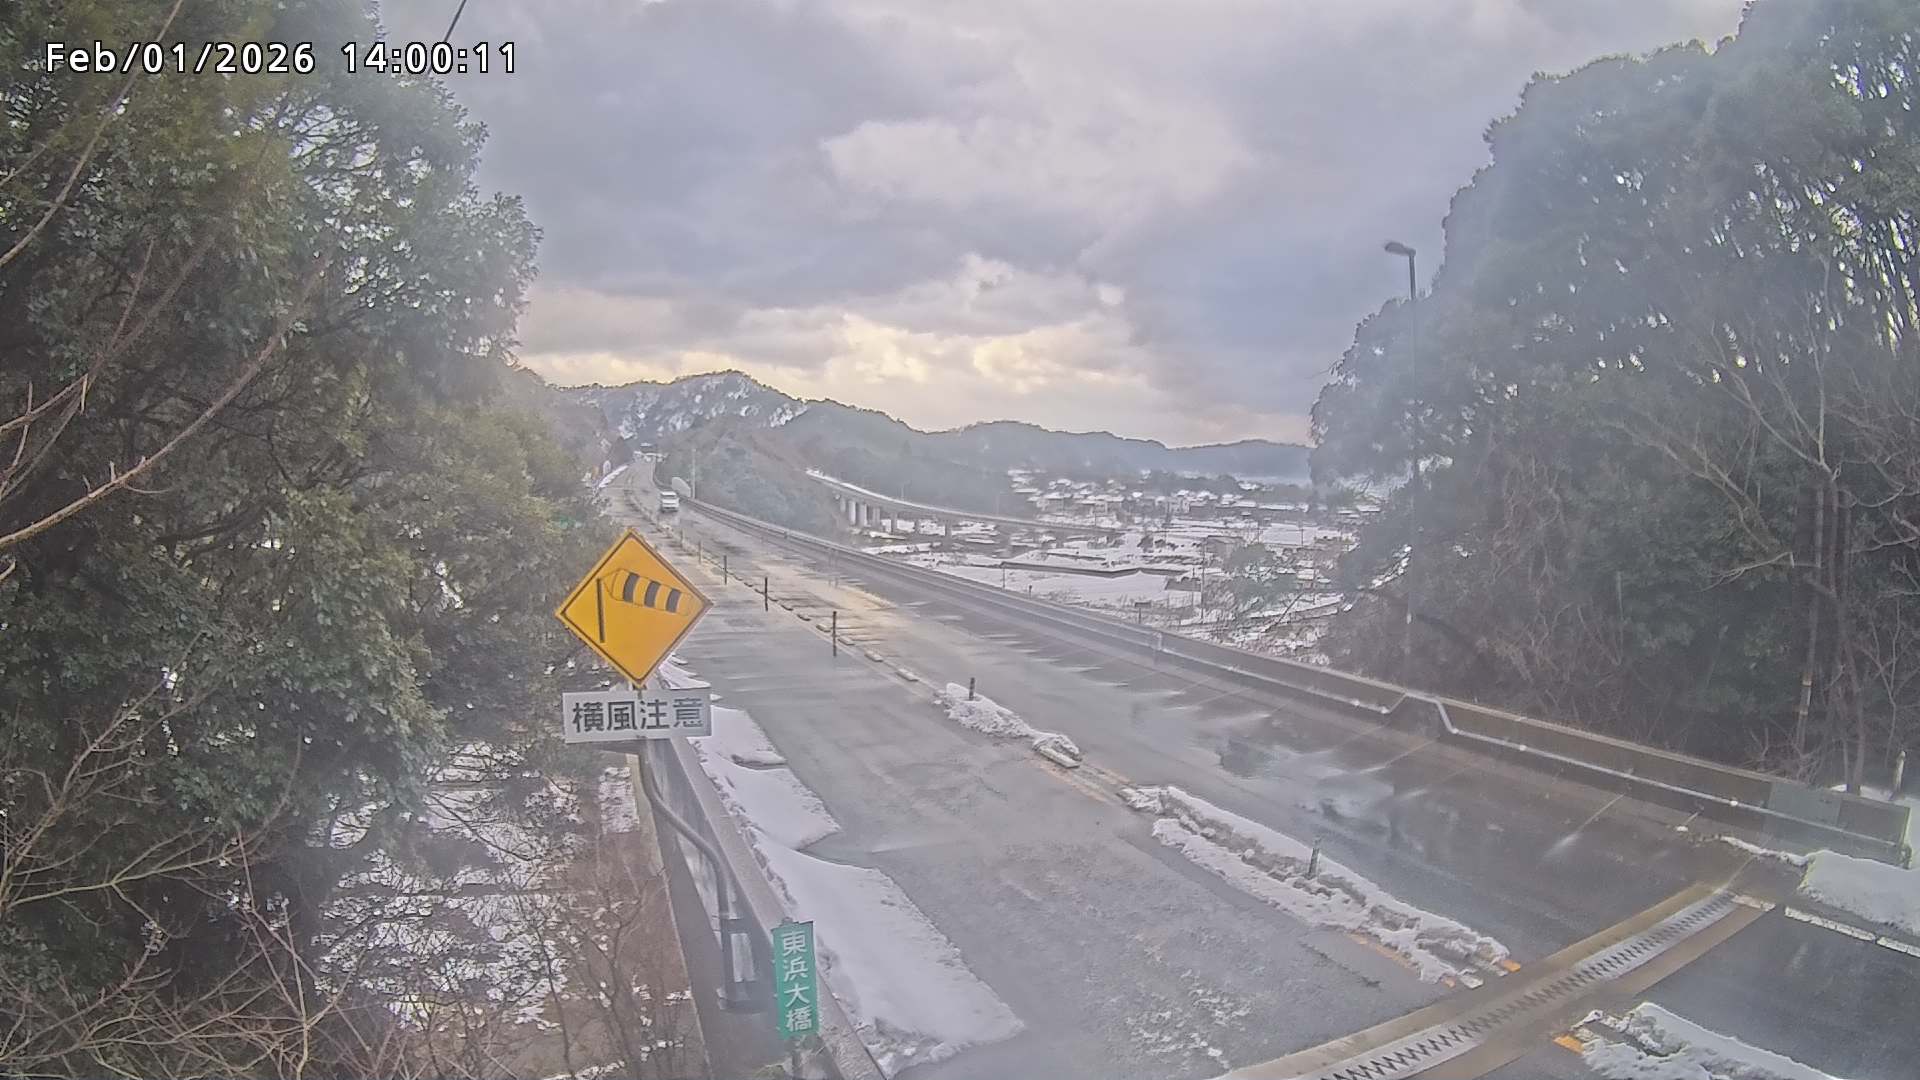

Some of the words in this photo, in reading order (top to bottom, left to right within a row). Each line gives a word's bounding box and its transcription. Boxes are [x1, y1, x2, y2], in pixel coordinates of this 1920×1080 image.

[572, 697, 704, 733] 横風注意
[780, 930, 813, 1033] 東浜大橋
